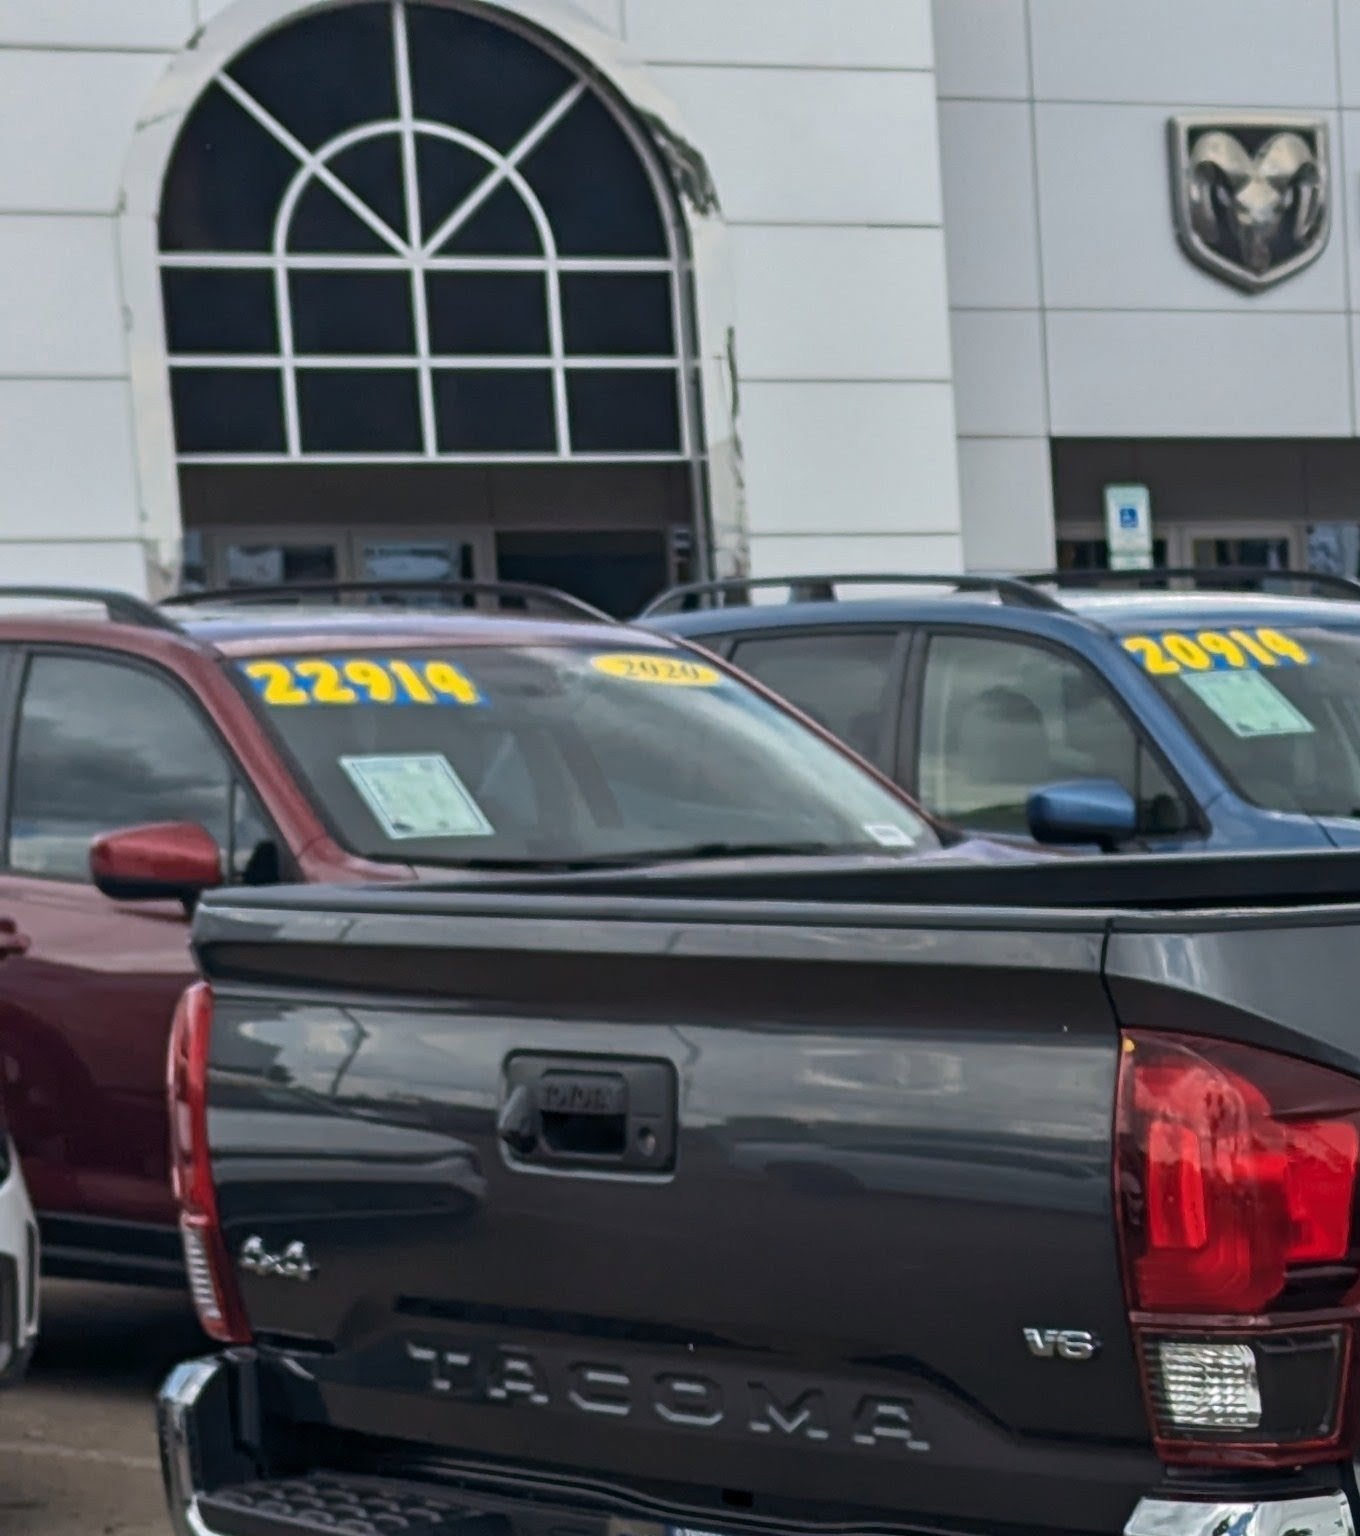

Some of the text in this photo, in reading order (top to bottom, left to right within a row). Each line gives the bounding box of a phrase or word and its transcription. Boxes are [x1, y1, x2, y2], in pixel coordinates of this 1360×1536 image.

[1122, 627, 1310, 674] 20914
[244, 660, 480, 704] 22914
[1023, 1328, 1094, 1359] V6
[406, 1342, 931, 1452] TACOMA
